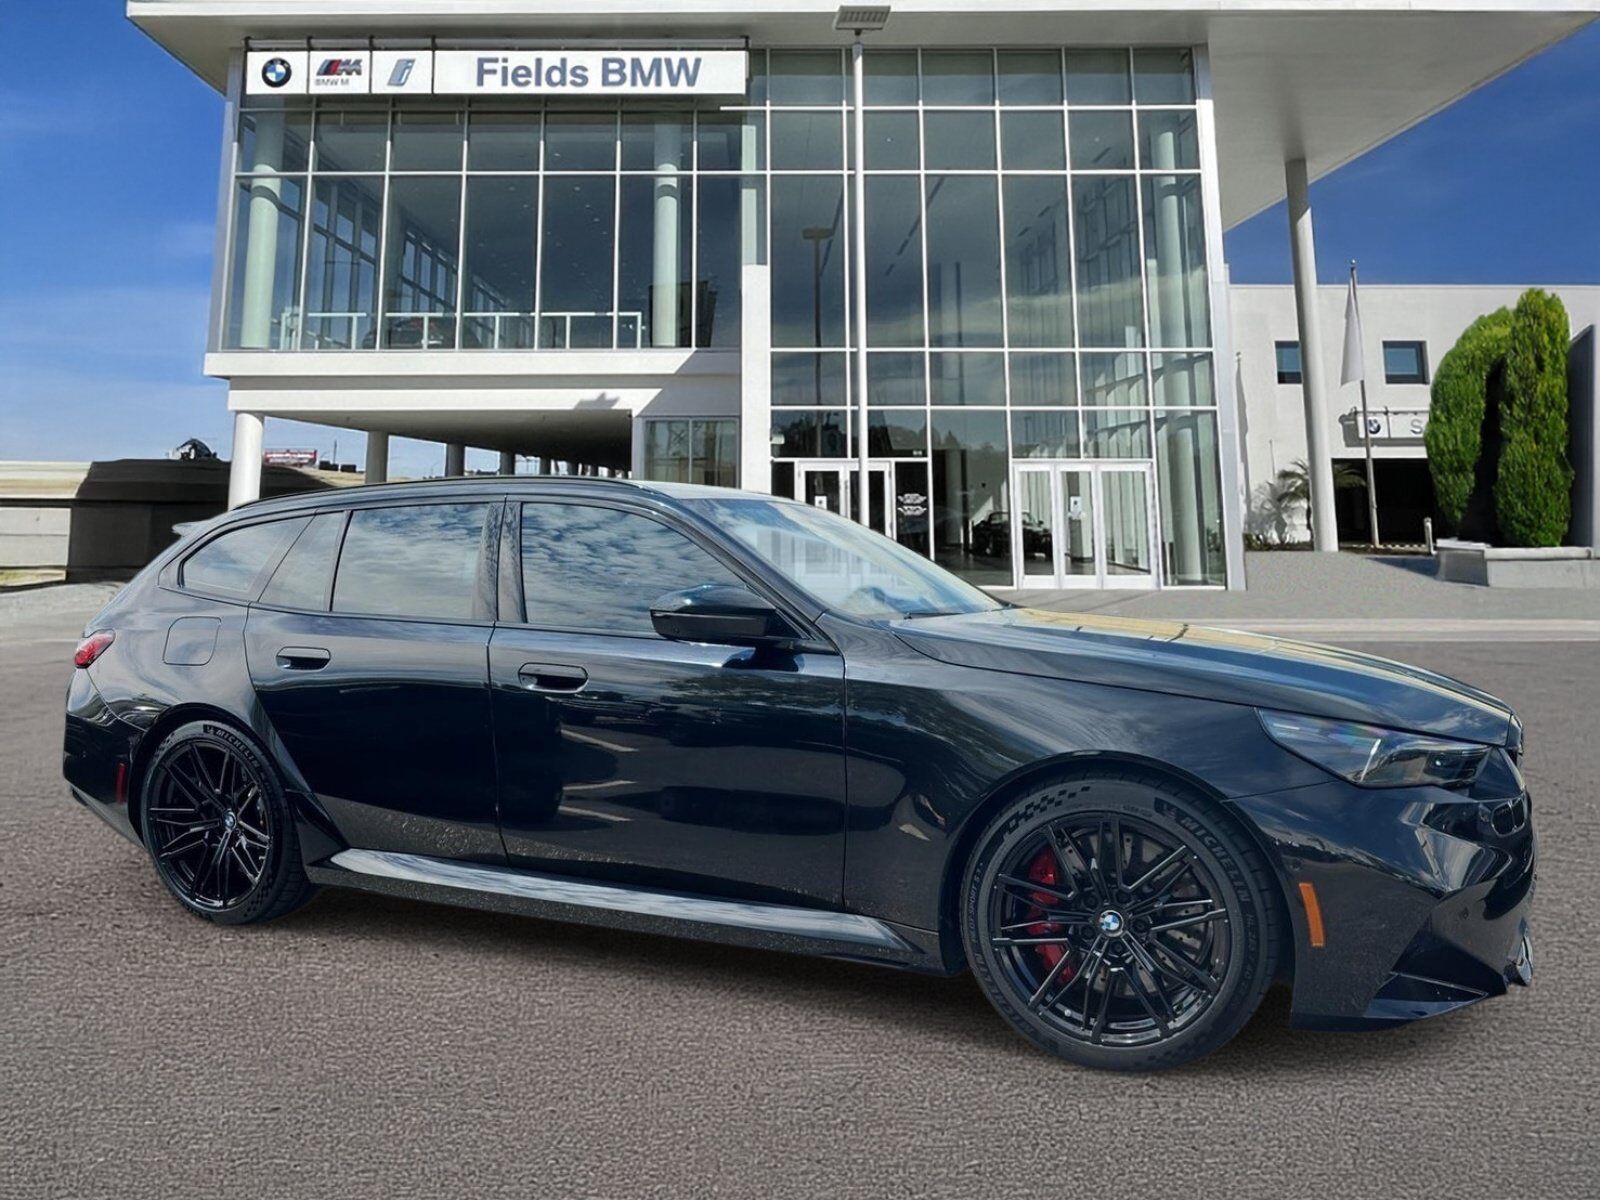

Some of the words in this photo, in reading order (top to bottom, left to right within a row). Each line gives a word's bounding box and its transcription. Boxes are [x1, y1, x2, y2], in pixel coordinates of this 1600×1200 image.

[315, 78, 338, 86] BMW
[477, 58, 589, 86] Fields
[601, 58, 703, 86] BMW
[216, 729, 260, 767] MICHELIN
[1180, 816, 1251, 902] MICHELIN
